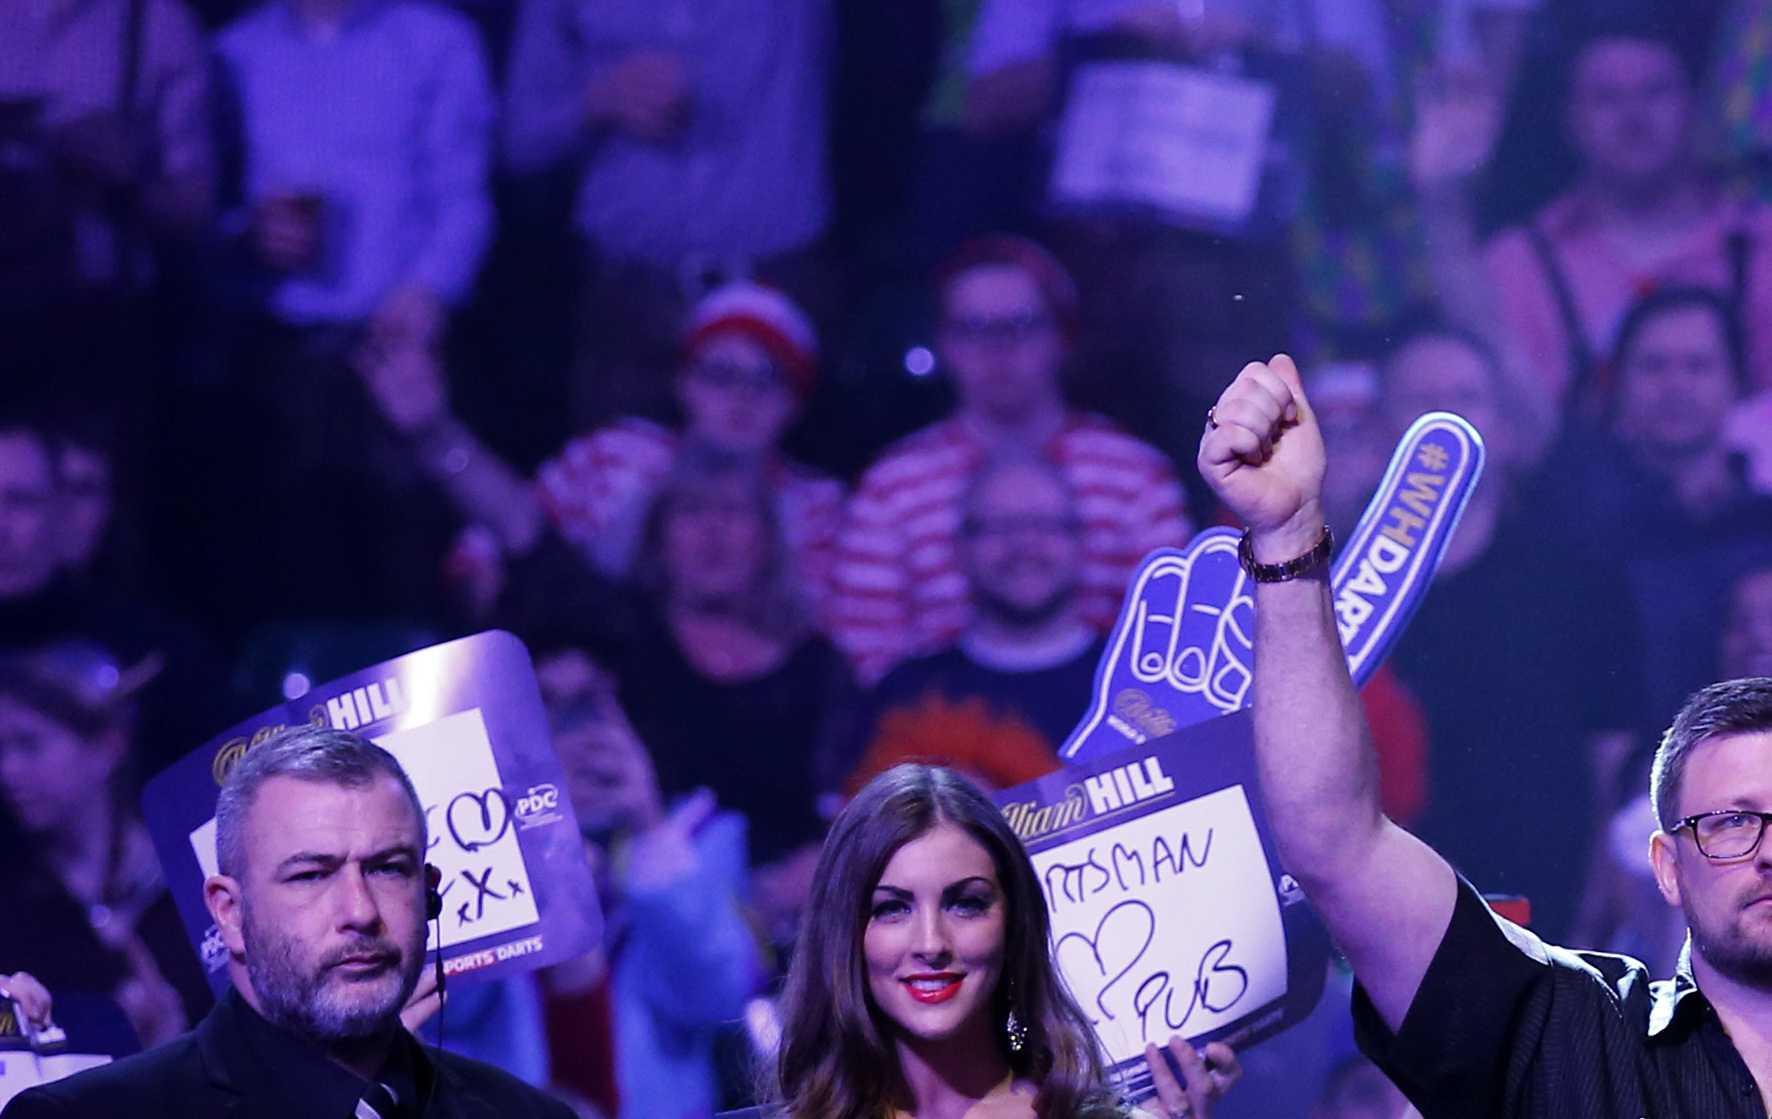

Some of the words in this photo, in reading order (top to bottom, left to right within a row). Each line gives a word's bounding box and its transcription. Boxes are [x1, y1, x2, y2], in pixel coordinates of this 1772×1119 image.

[1084, 755, 1176, 815] HILL
[442, 949, 495, 976] PORTS
[1134, 938, 1249, 1043] PUB
